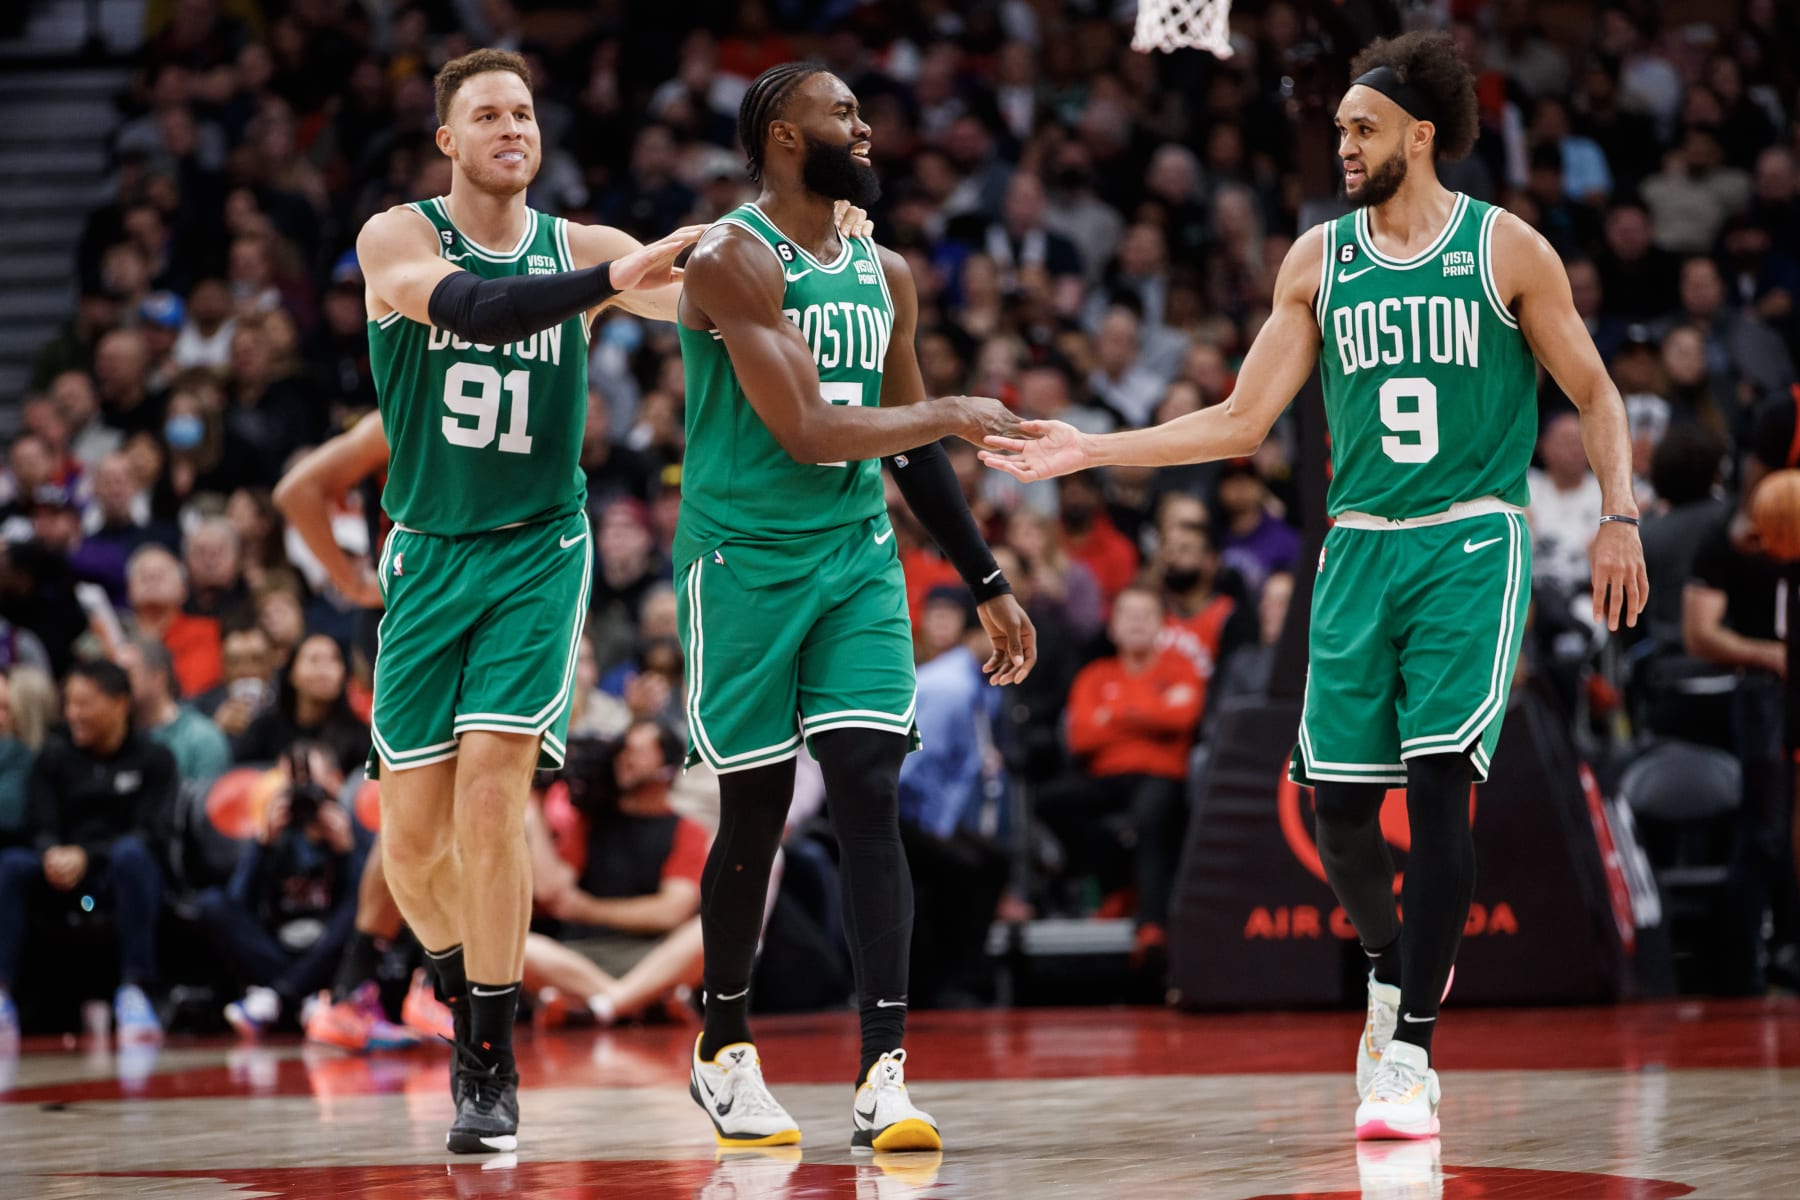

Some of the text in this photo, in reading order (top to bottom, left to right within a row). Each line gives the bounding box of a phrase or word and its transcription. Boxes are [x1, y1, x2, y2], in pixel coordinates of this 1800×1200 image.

[778, 244, 793, 261] 6
[1341, 245, 1354, 262] 6
[1442, 252, 1475, 265] VISTA
[527, 255, 556, 269] VISTA
[853, 259, 874, 274] VISTA
[1442, 264, 1475, 277] PRINT
[858, 274, 877, 285] PRINT
[782, 302, 891, 373] OSTON
[1333, 296, 1480, 376] BOSTON
[442, 361, 533, 455] 91
[1379, 377, 1440, 464] 9
[1244, 902, 1519, 940] AIR CDA
